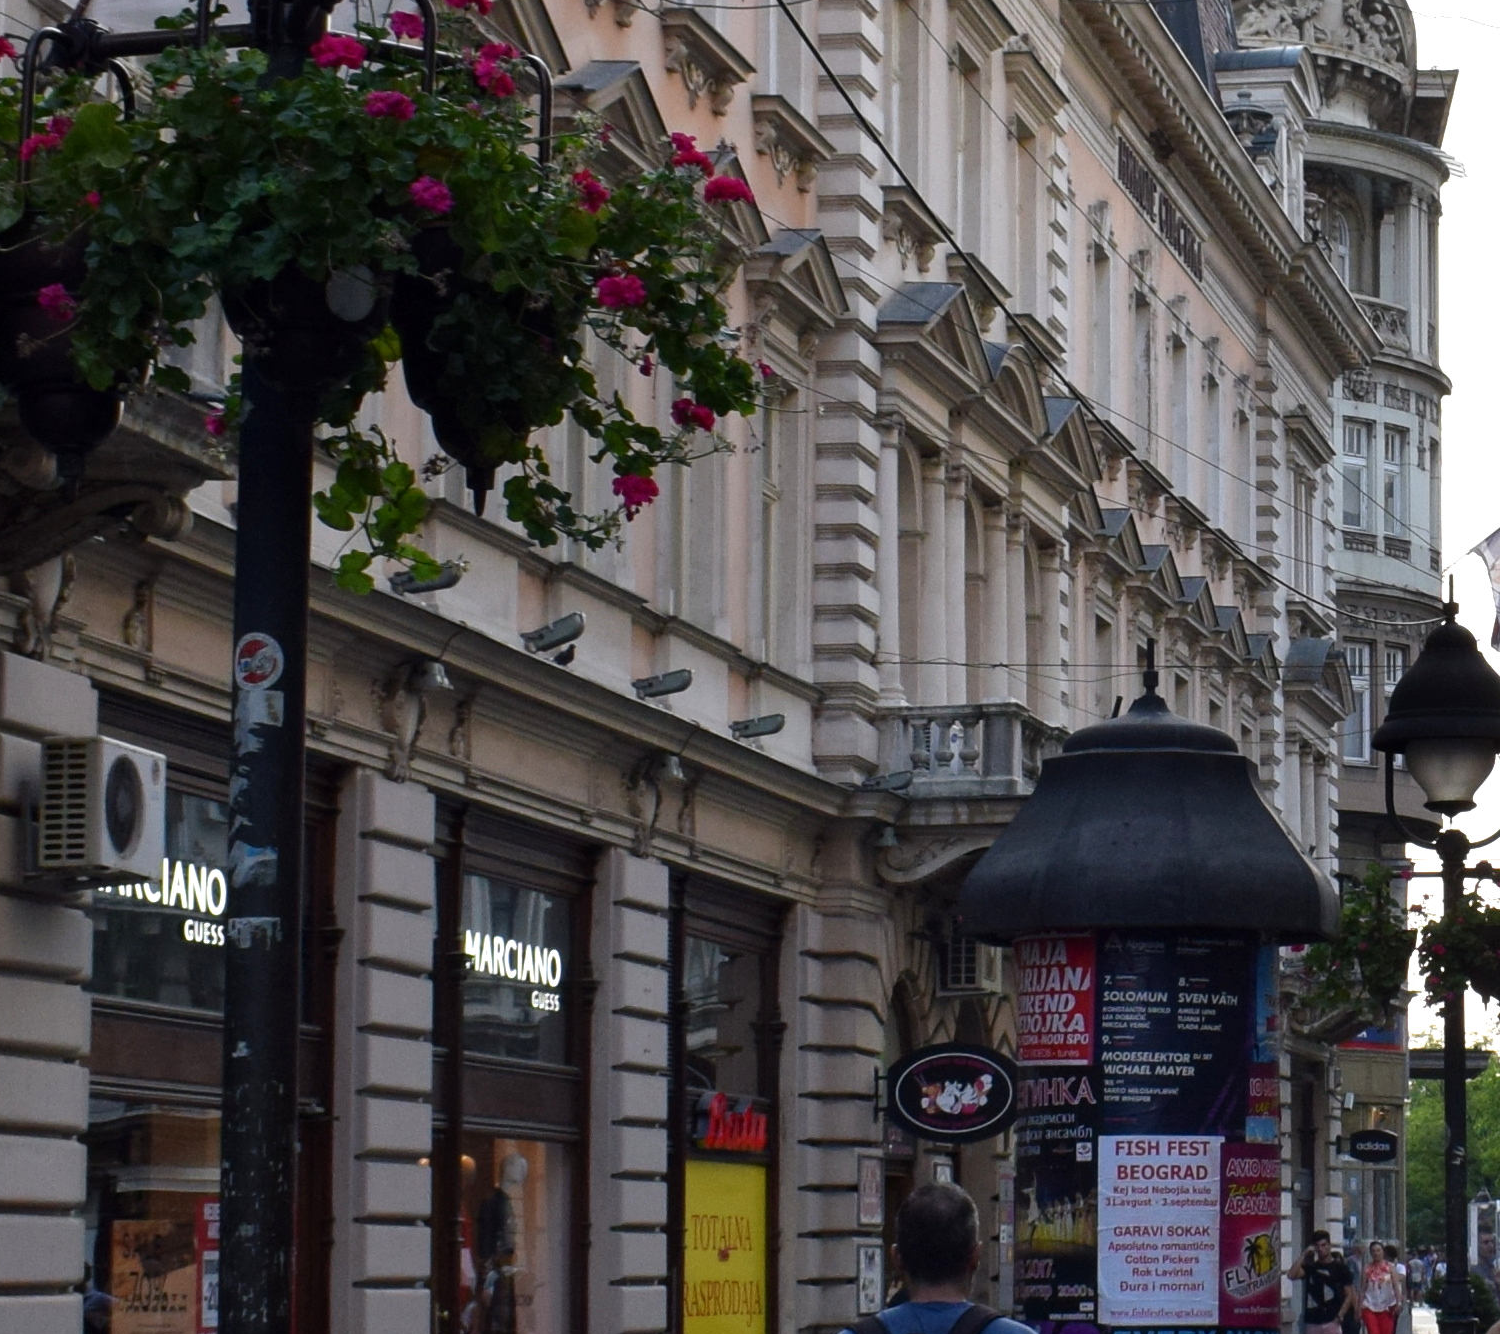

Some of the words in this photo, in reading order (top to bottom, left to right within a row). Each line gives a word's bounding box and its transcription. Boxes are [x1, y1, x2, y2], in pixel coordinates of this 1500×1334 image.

[184, 918, 226, 947] GUESS
[465, 929, 562, 987] MARCIANO
[530, 990, 560, 1012] GUESS
[1102, 991, 1169, 1003] SOLOMUN
[1178, 992, 1209, 1004] SVEN
[1101, 1051, 1191, 1064] MODESELEKTOR
[1103, 1065, 1152, 1076] MICHAEL
[1154, 1066, 1196, 1077] MAYER
[1115, 1141, 1160, 1157] FISH
[1167, 1141, 1211, 1157] FEST
[1356, 1141, 1391, 1152] adidas
[1117, 1165, 1209, 1181] BEOGRAD
[1113, 1185, 1129, 1197] Kej
[1132, 1184, 1150, 1195] kod
[690, 1214, 753, 1251] TOTALNA
[1113, 1226, 1163, 1237] GARAVI
[1166, 1226, 1211, 1237] SOKAK
[1125, 1254, 1160, 1265] Cotton
[1162, 1254, 1201, 1265] Pickers
[1132, 1268, 1153, 1278] Rok
[682, 1280, 763, 1328] RASPRODAJA
